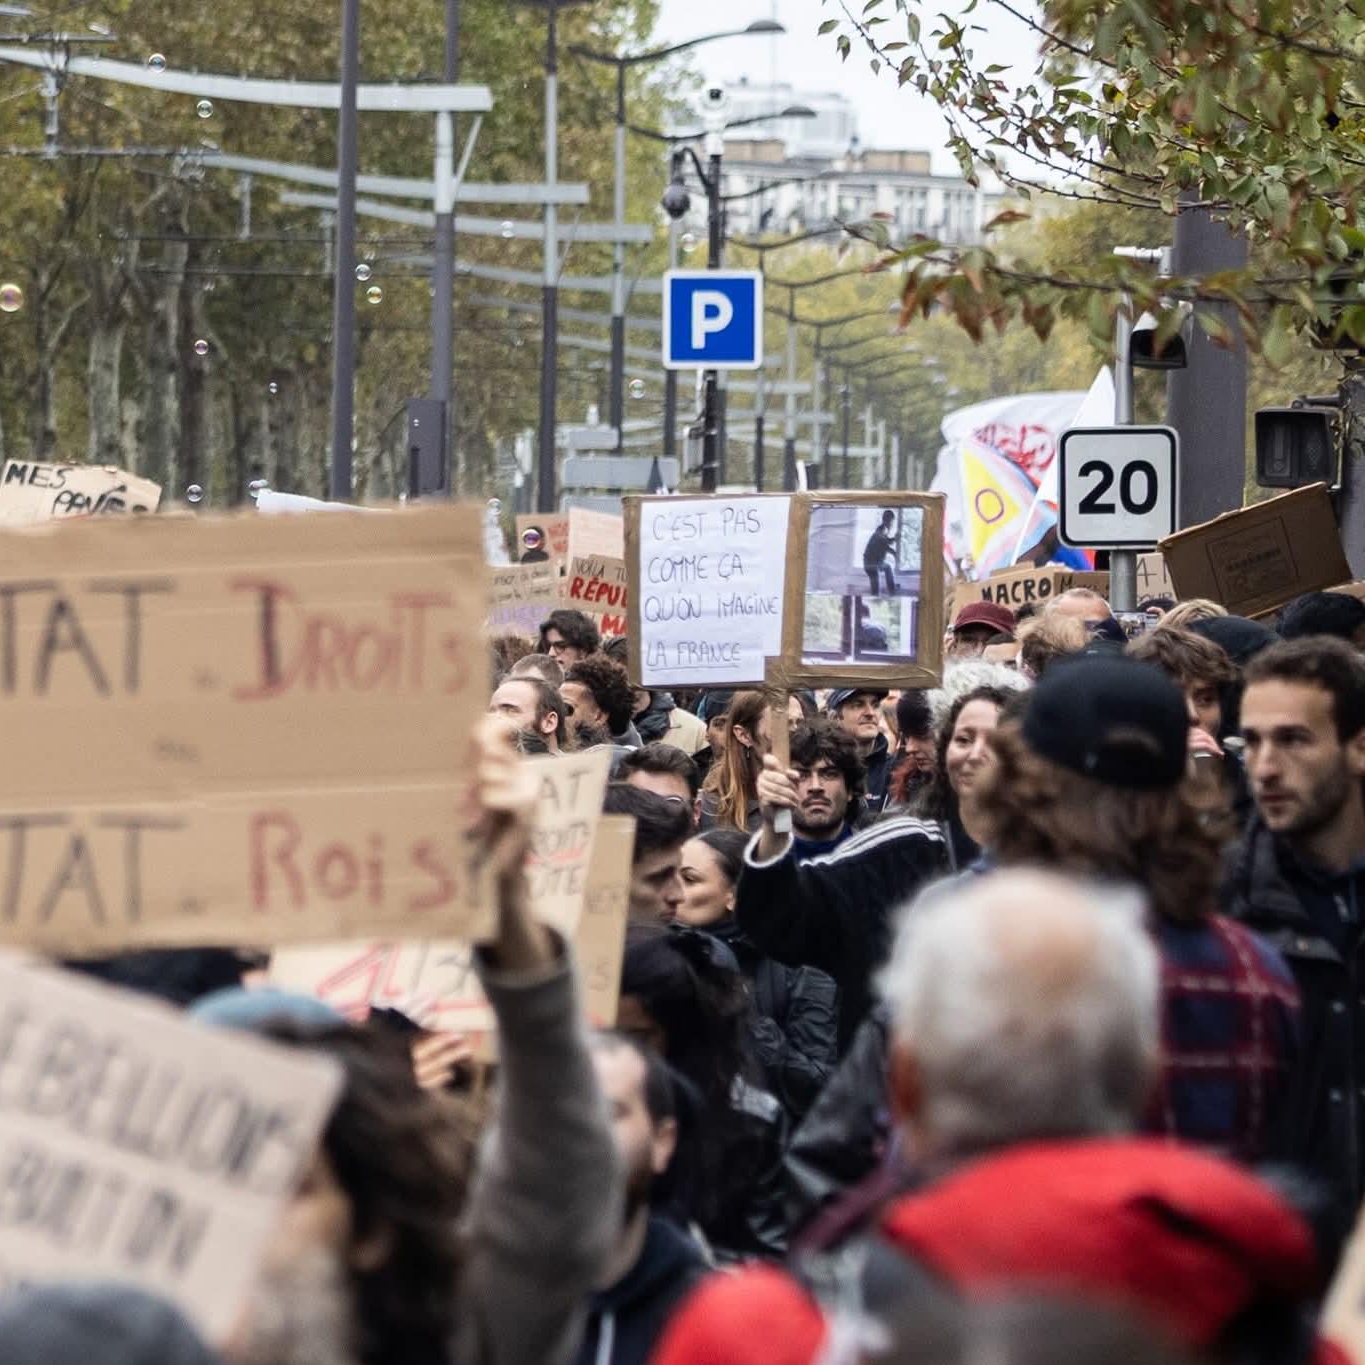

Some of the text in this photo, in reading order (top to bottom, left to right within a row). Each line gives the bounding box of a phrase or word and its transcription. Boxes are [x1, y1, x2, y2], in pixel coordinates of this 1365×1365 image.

[691, 290, 734, 349] P
[5, 463, 75, 489] MES
[1078, 460, 1158, 515] 20
[723, 506, 761, 537] PAS
[647, 555, 710, 584] COMME
[645, 641, 742, 669] LA FRANCE
